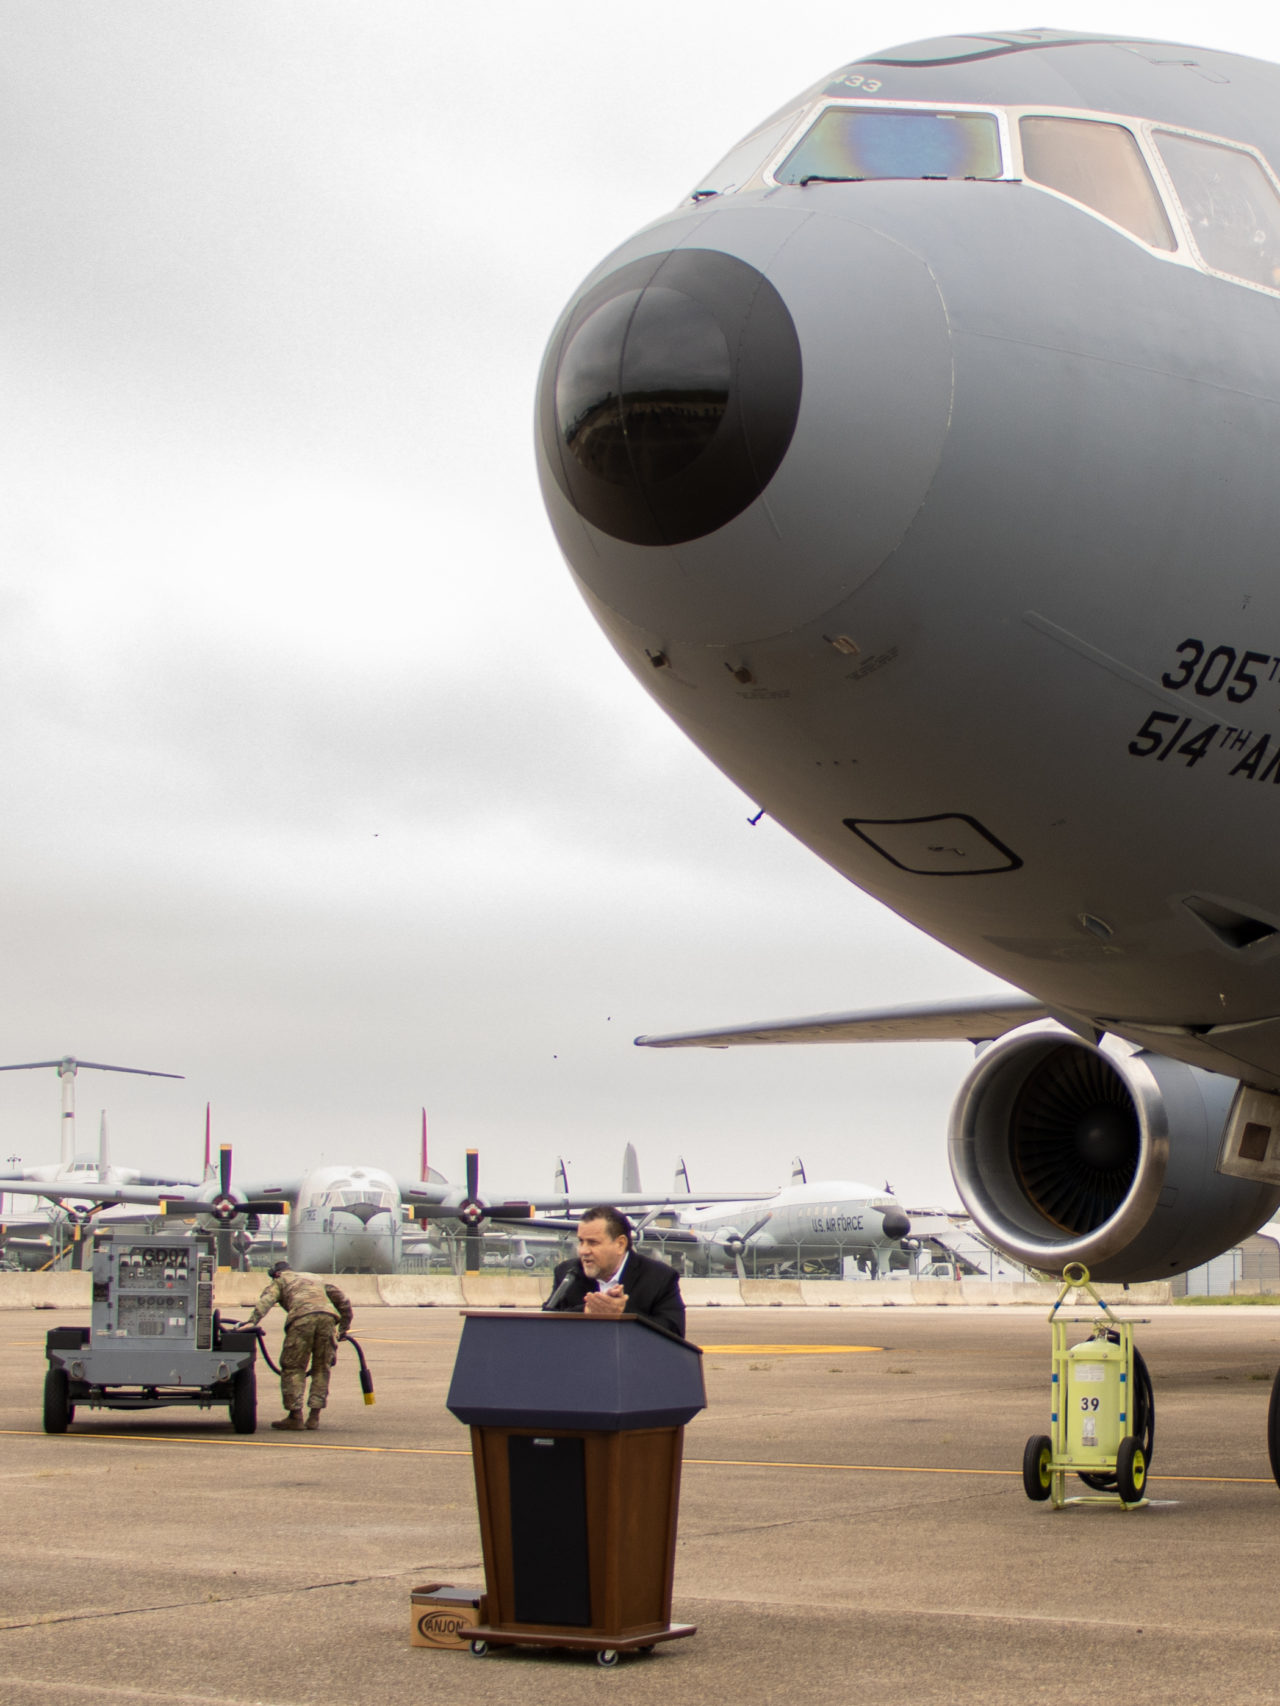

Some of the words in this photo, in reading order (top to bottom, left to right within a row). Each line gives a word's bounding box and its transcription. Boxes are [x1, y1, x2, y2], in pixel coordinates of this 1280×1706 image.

[811, 1218, 826, 1233] U.S.
[825, 1218, 837, 1232] AIR
[837, 1215, 864, 1232] FORCE
[1081, 1397, 1100, 1412] 39
[424, 1618, 465, 1633] ANJON
